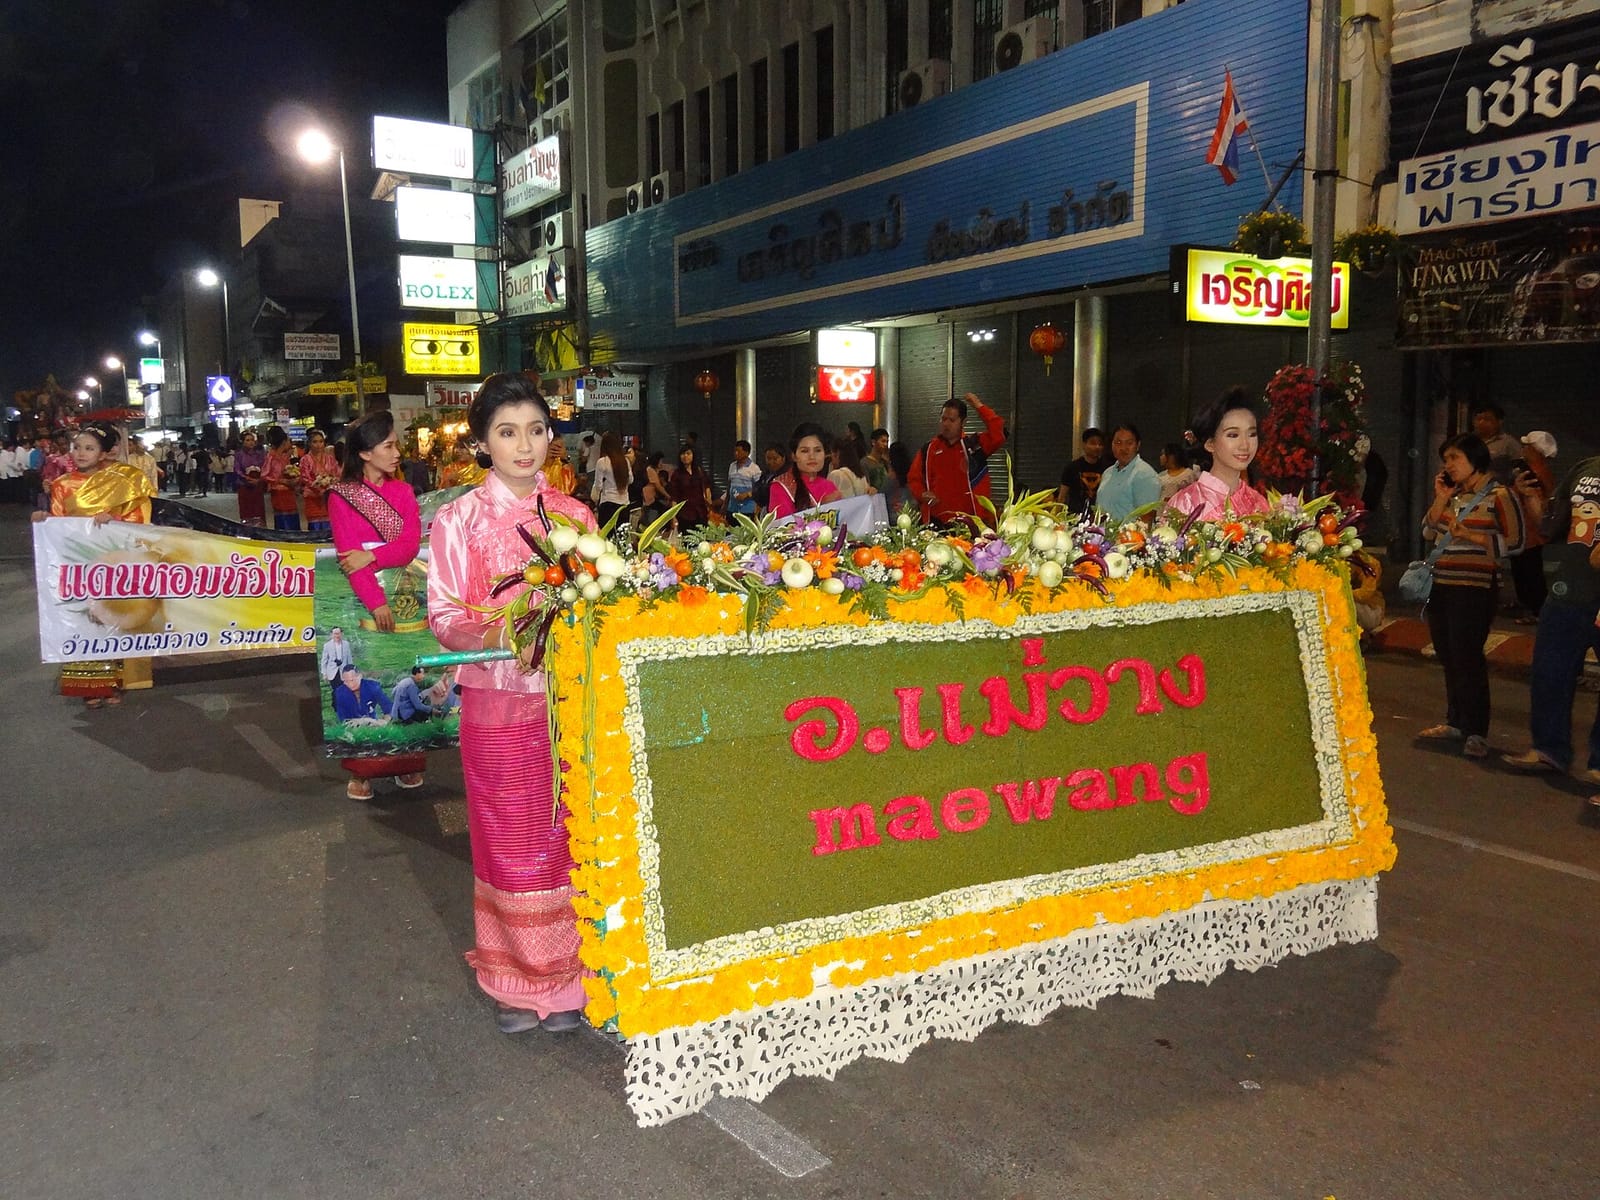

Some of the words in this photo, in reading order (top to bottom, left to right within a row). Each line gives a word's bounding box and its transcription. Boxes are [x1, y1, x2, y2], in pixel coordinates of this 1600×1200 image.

[1465, 37, 1600, 134] เชีย
[406, 283, 475, 300] ROLEX
[62, 624, 208, 655] อำเภอแม่วาง
[219, 621, 293, 646] ร่วมกับ
[783, 638, 1207, 763] อ.แม่วาง
[809, 751, 1212, 857] maewang
